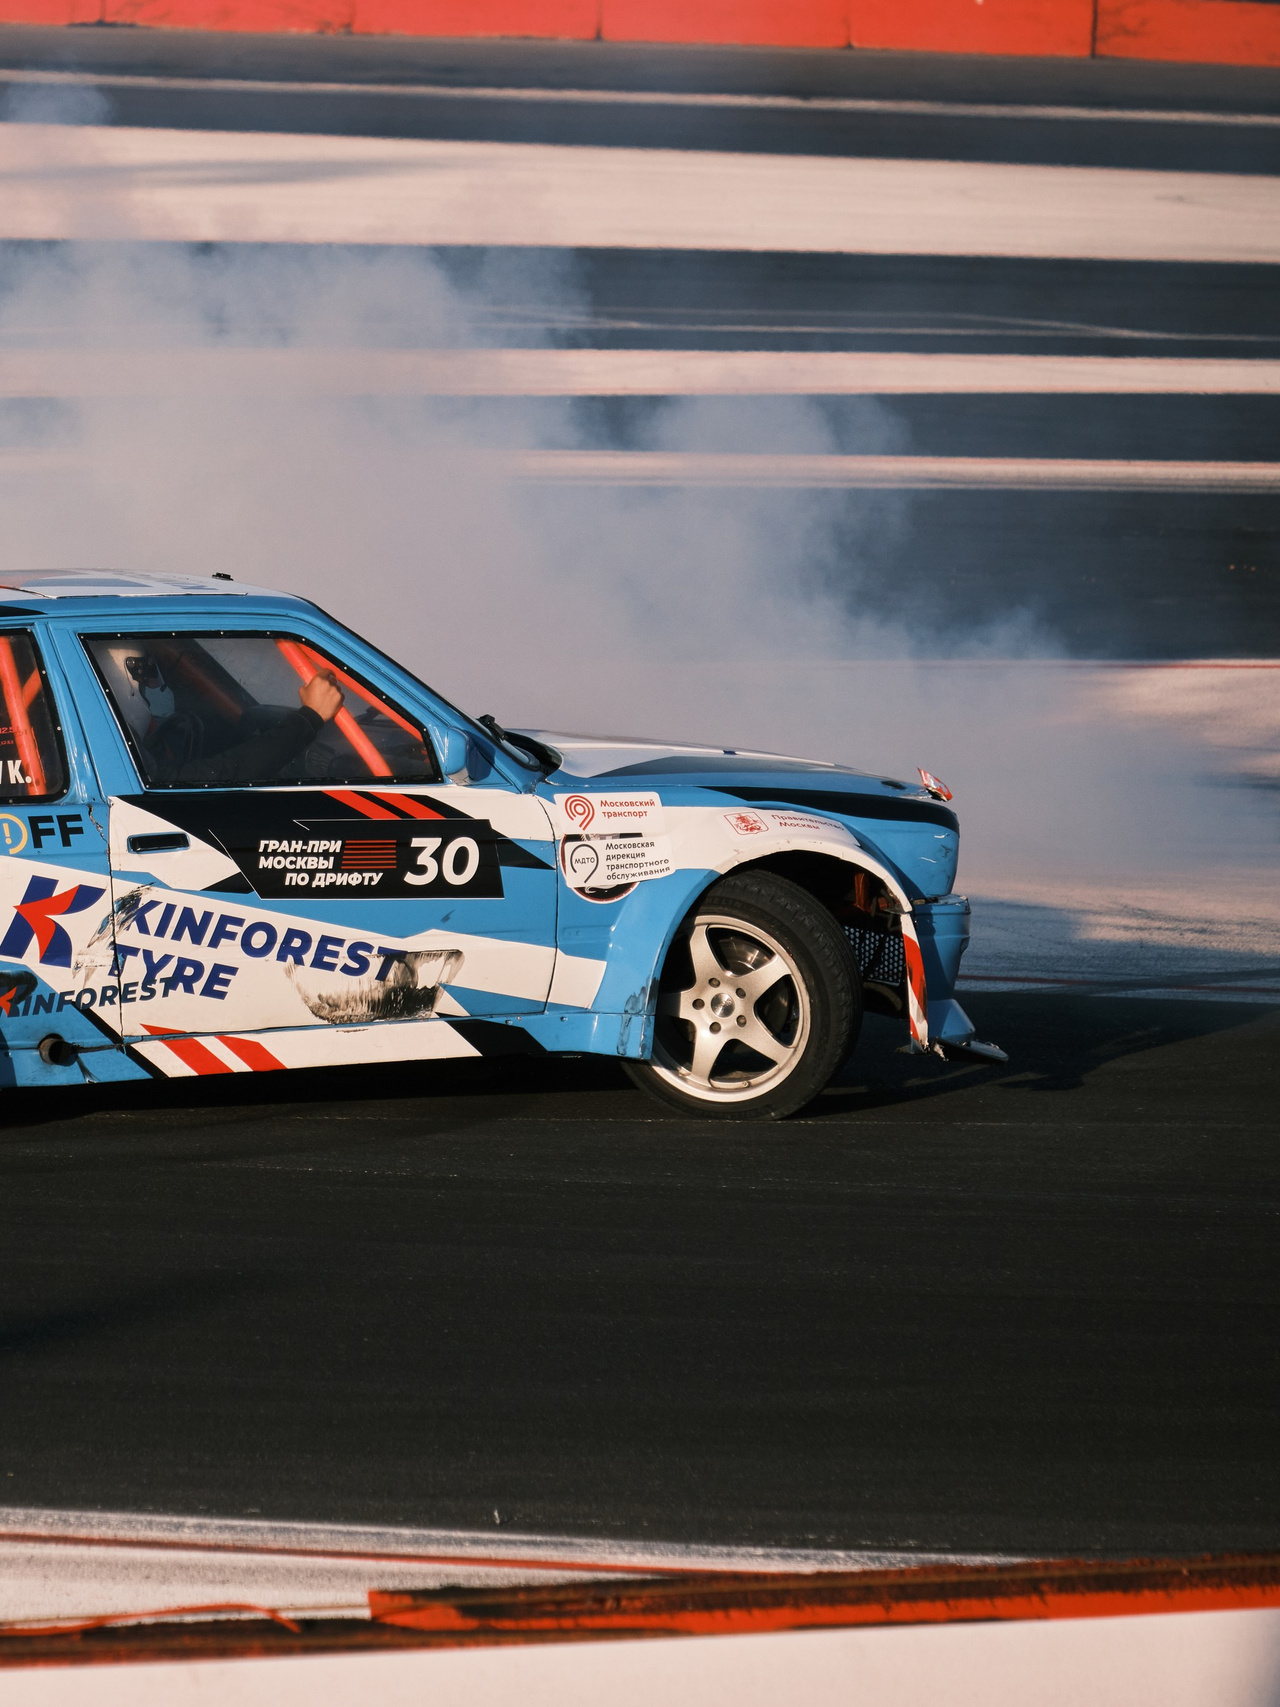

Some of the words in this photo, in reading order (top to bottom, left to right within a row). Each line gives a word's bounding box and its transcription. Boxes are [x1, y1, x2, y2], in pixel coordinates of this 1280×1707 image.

[7, 759, 32, 785] K.
[600, 799, 656, 808] Московский
[602, 810, 648, 819] транспорт
[779, 821, 821, 830] Москвы
[258, 840, 342, 853] ГРАН-ПРИ
[605, 841, 655, 851] Московская
[258, 856, 334, 869] МОСКВЫ
[403, 836, 480, 886] 30
[574, 857, 596, 865] МДТО
[606, 851, 646, 862] дирекция
[606, 858, 670, 871] транспортного
[285, 872, 310, 886] ПО
[312, 872, 384, 887] ДРИФТУ
[606, 866, 671, 880] обслуживания
[127, 898, 408, 982] KINFOREST
[108, 943, 239, 1001] TYRE
